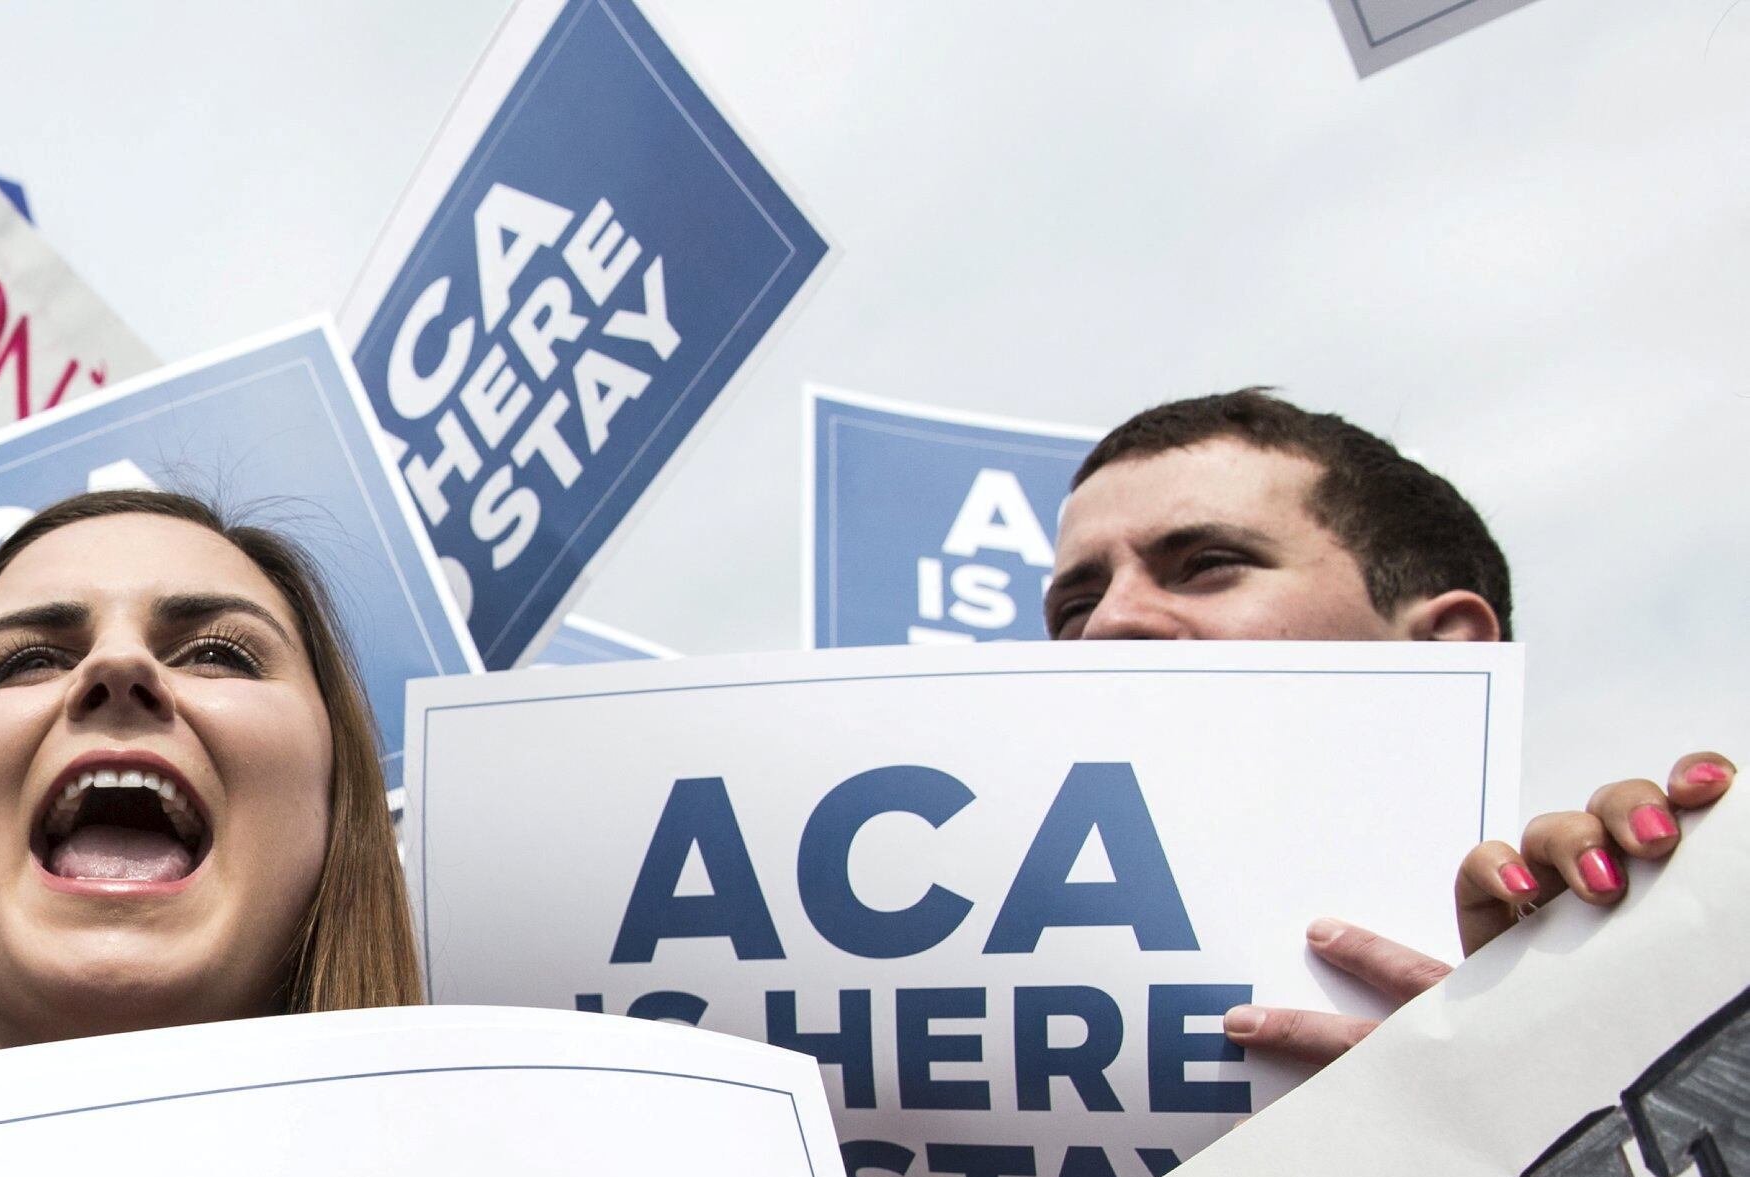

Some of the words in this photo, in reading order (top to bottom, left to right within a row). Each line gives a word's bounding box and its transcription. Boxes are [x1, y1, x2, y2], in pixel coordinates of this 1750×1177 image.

[381, 182, 576, 464] CA
[403, 197, 643, 527] HERE
[469, 255, 682, 570] STAY
[916, 556, 1017, 630] IS
[609, 761, 1202, 965] ACA
[764, 984, 1253, 1114] HERE
